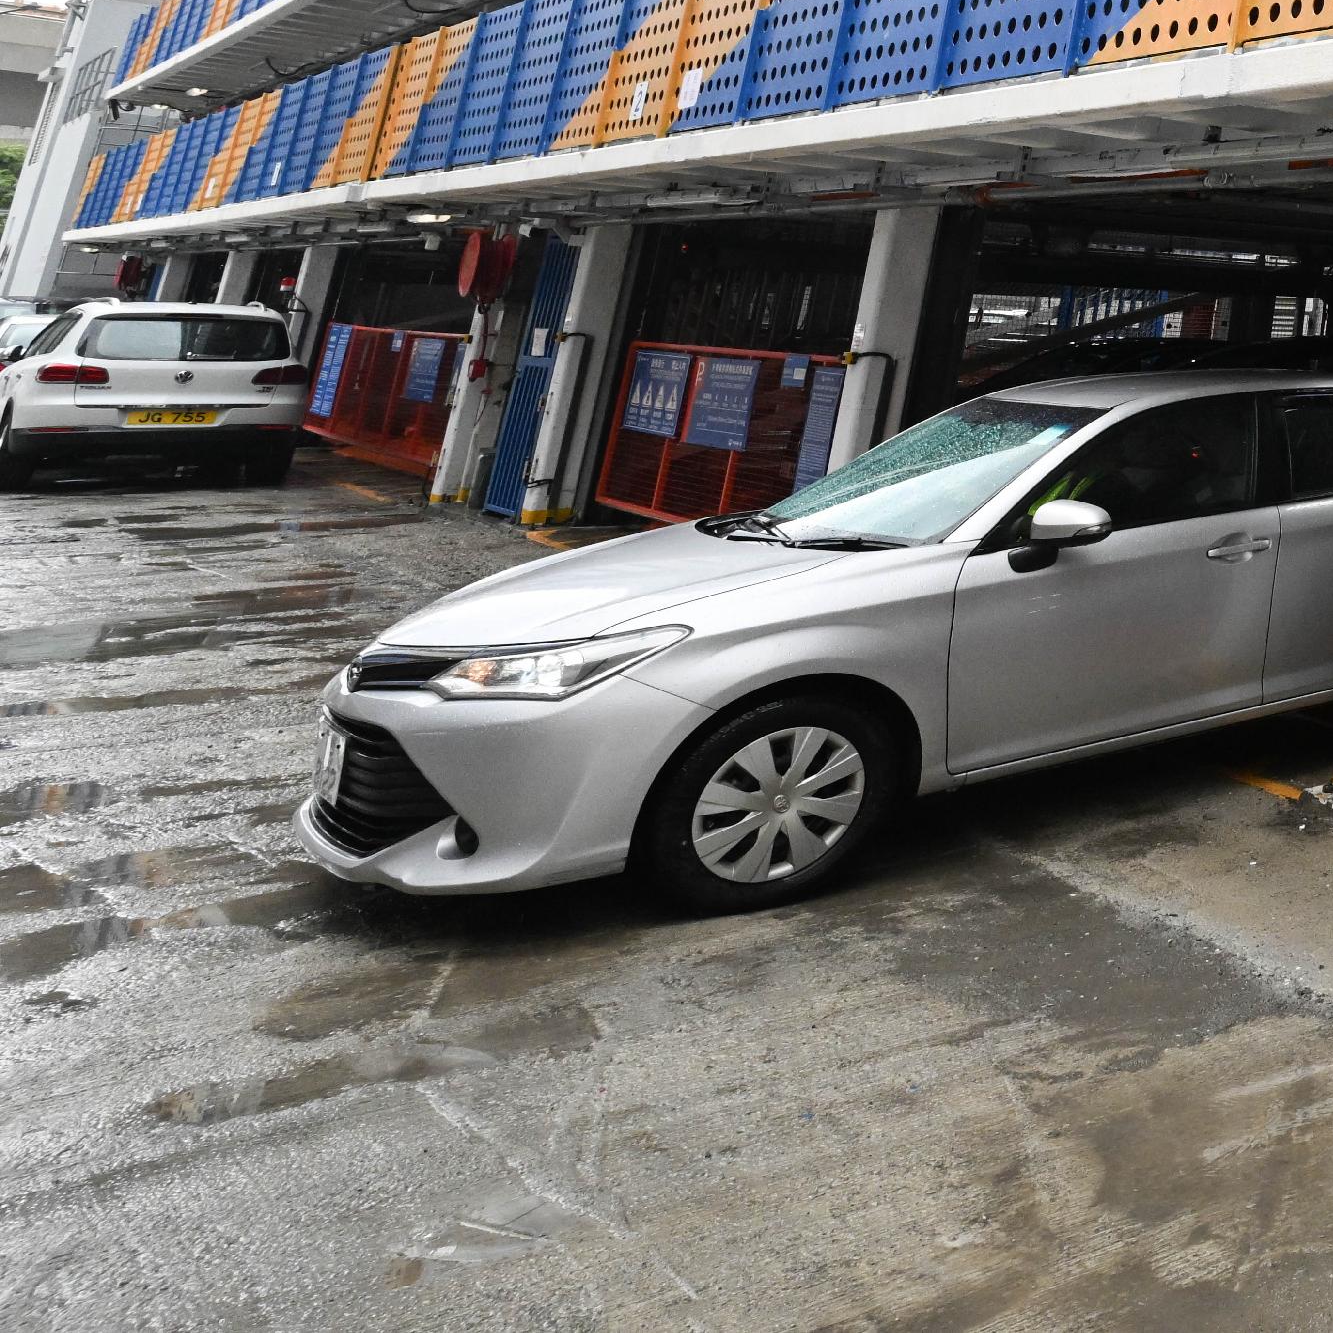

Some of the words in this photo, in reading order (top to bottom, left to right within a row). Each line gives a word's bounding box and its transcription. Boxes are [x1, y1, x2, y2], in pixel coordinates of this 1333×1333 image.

[635, 90, 643, 112] 2
[139, 412, 162, 423] JG
[172, 412, 206, 422] 755
